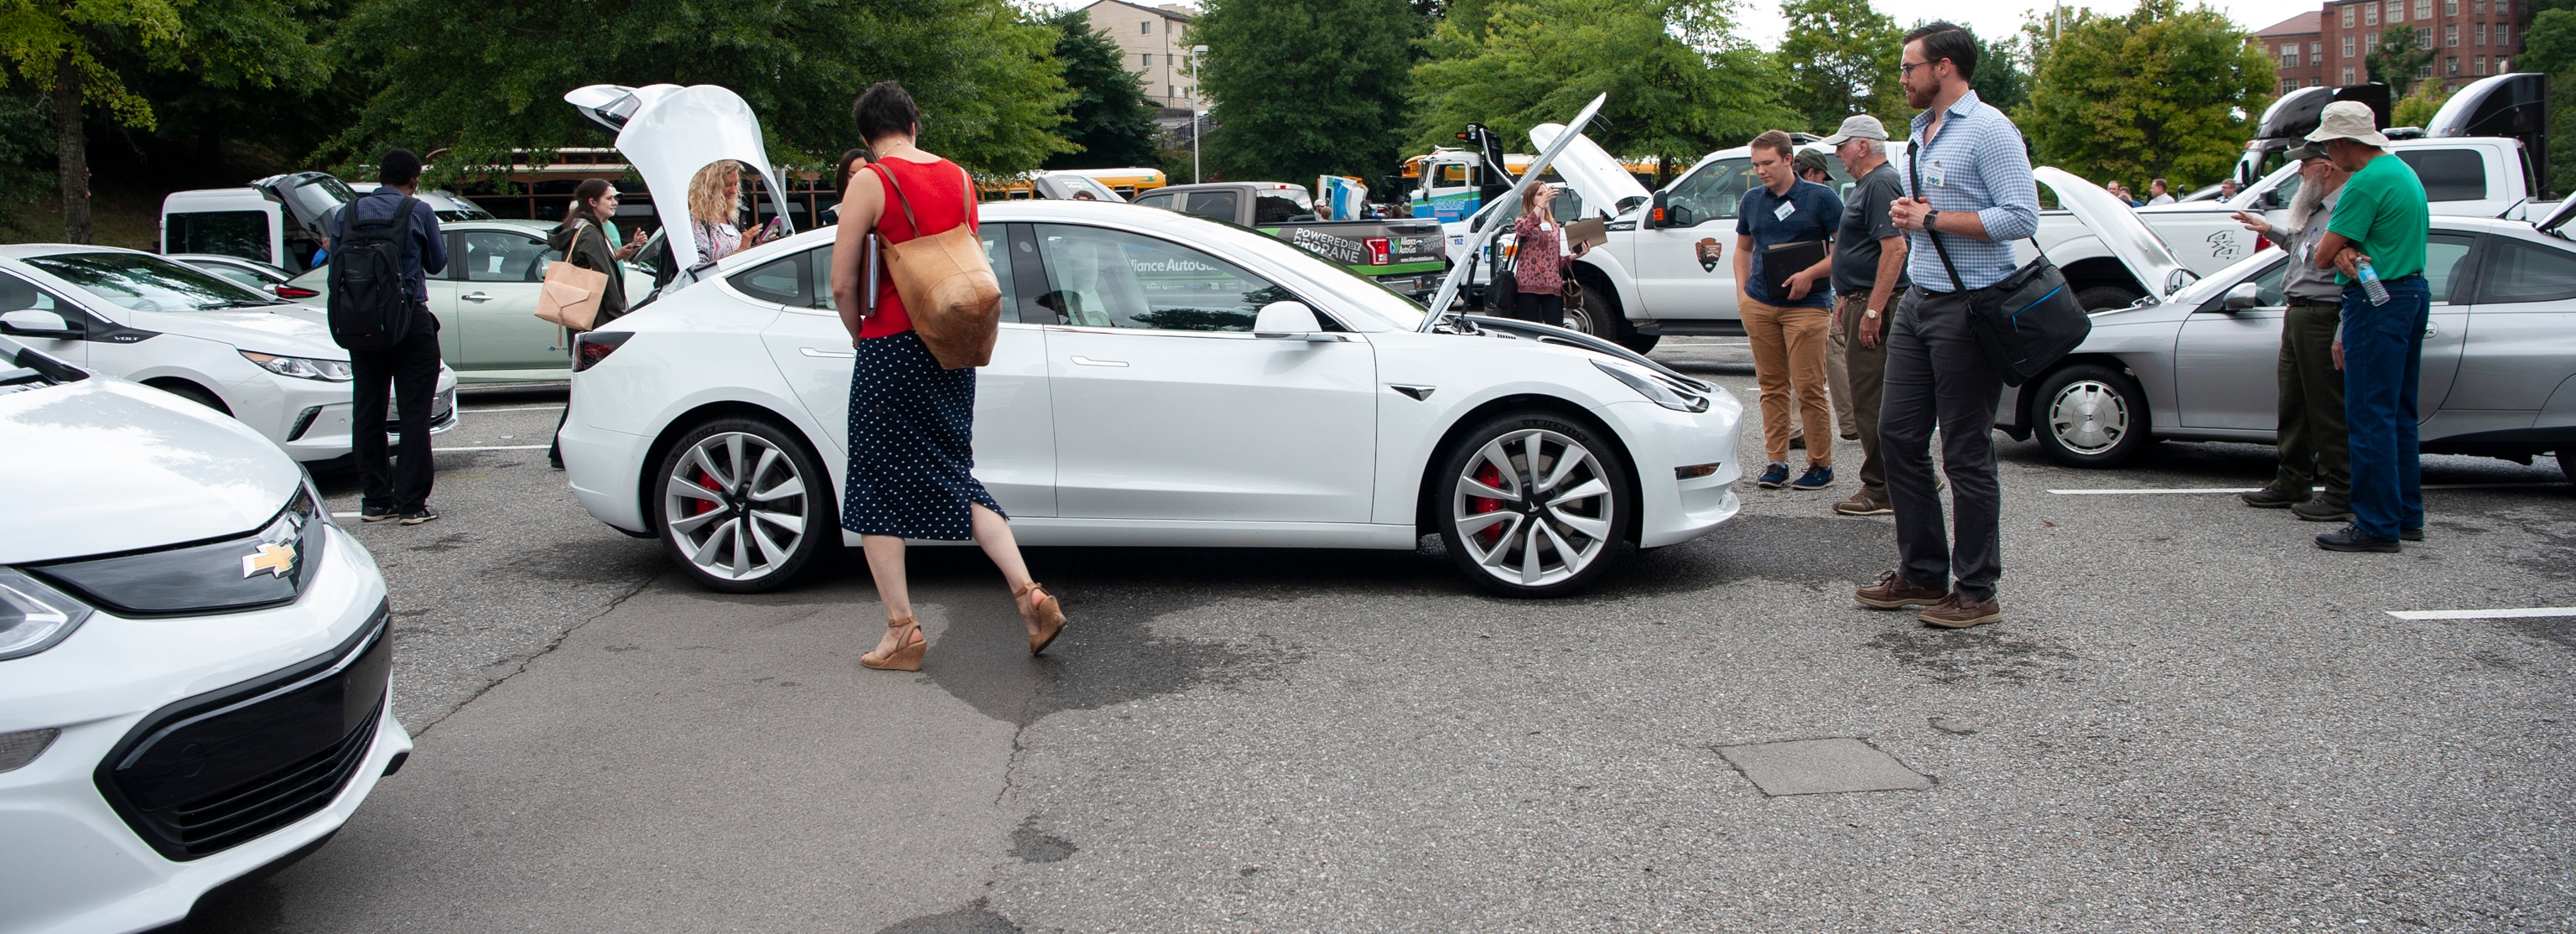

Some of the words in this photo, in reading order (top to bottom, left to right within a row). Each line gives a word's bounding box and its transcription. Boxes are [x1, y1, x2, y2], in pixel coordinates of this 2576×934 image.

[1433, 198, 1466, 209] CNG
[1292, 235, 1360, 264] PROPANE
[1295, 227, 1348, 249] POWERED
[1348, 240, 1362, 252] BY
[1536, 420, 1585, 441] MICHELIN
